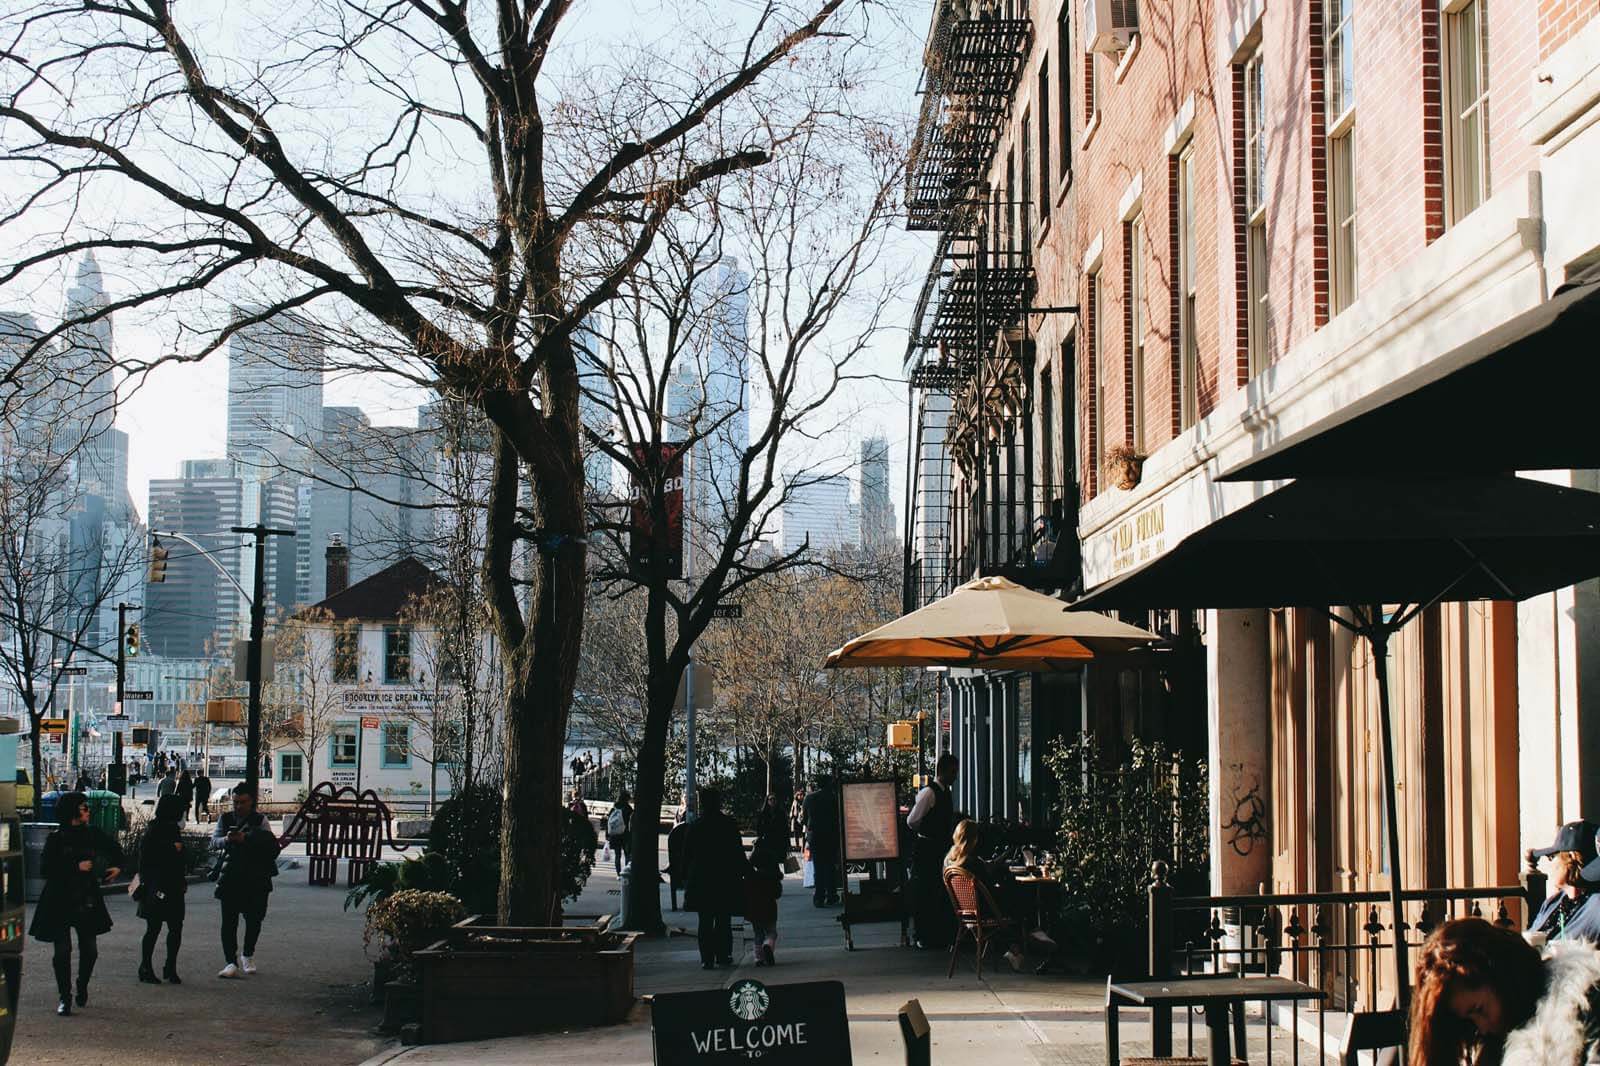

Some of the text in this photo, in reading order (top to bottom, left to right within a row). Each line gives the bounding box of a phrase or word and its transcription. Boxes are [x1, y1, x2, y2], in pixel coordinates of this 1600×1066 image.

[631, 476, 683, 501] DBO
[145, 691, 152, 699] St
[344, 692, 379, 702] BROOKLYN
[381, 693, 392, 702] ICE
[395, 693, 418, 702] CREAM
[690, 1022, 807, 1054] WELCOME
